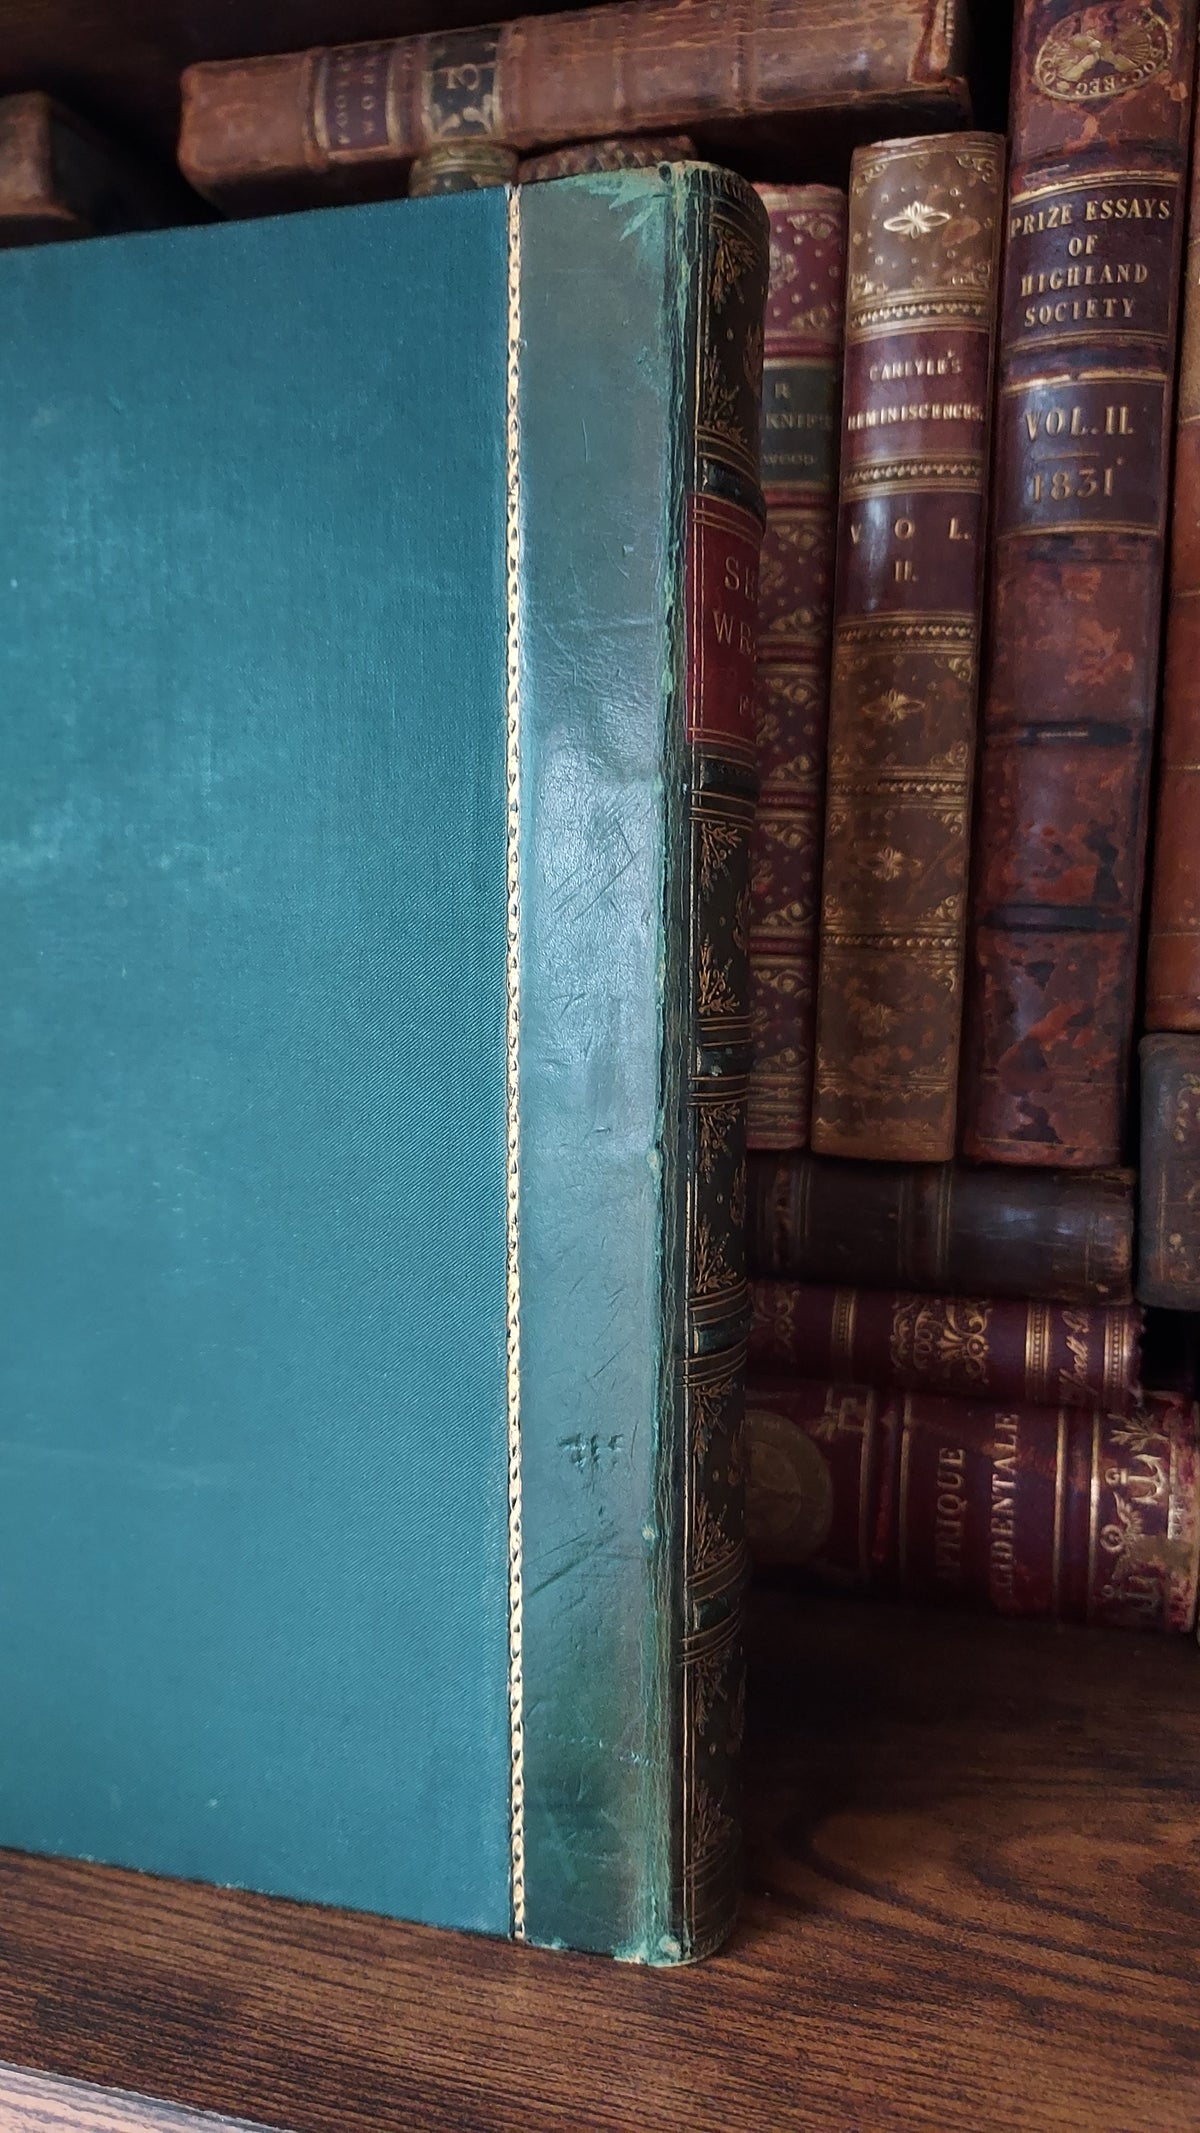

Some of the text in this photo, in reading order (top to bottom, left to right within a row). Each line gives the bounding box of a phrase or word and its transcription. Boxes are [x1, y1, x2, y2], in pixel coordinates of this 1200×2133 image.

[1010, 199, 1171, 236] PRIZE ESSAYS
[1068, 235, 1099, 258] OF
[1021, 263, 1148, 297] HIGHLAND
[1025, 298, 1136, 327] SOCIETY
[1025, 406, 1098, 442] VOL.
[1031, 466, 1114, 501] 1831
